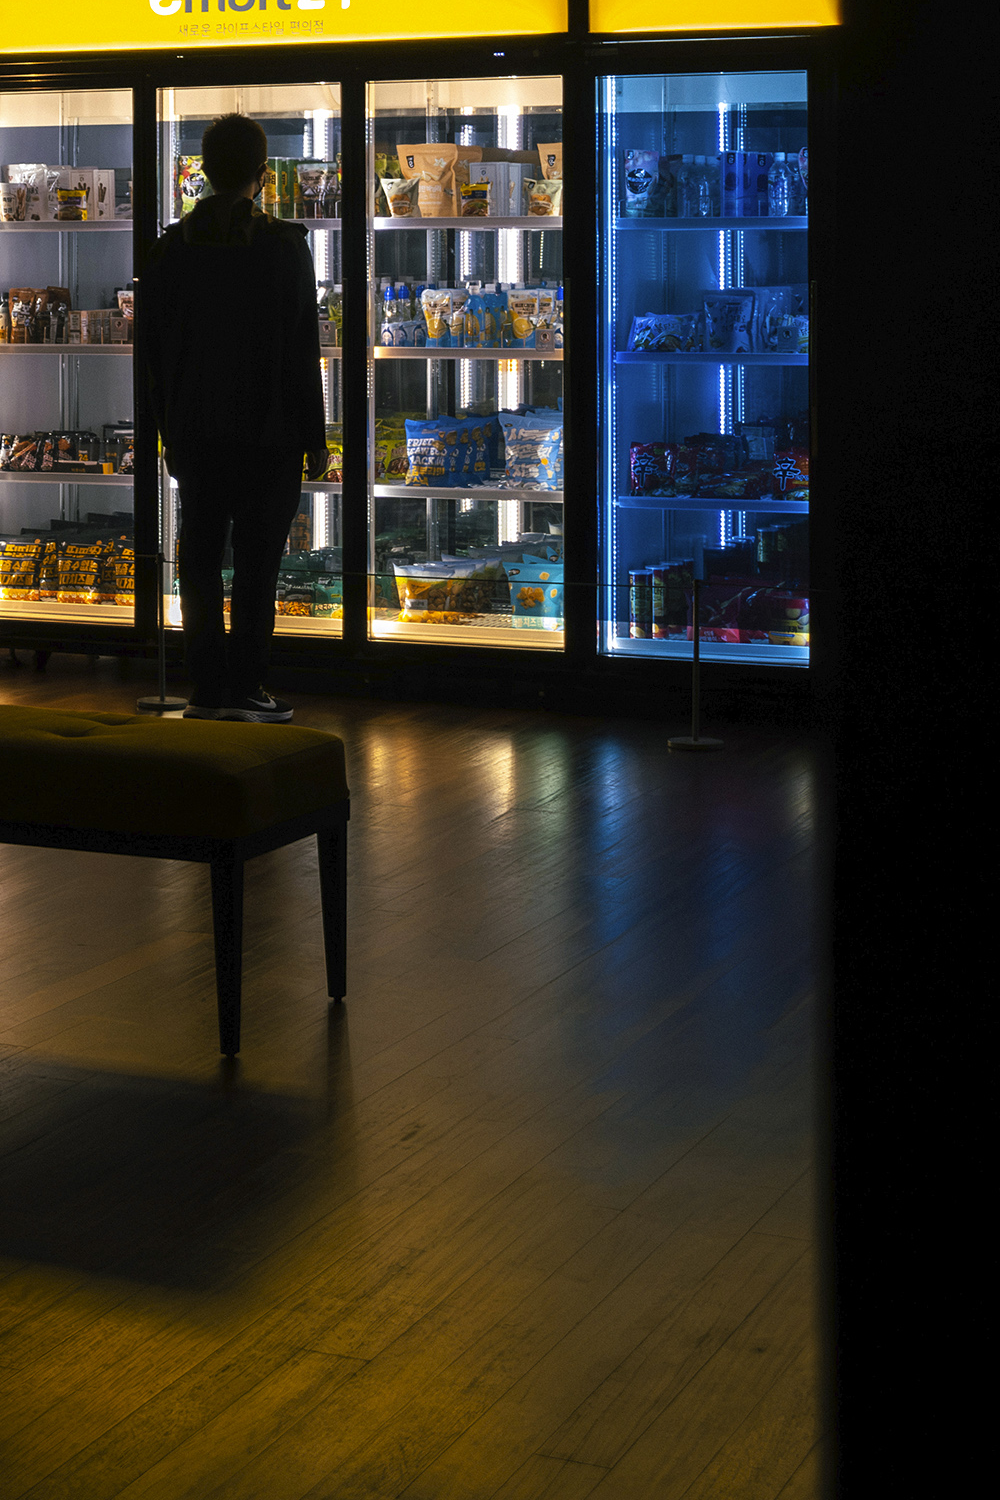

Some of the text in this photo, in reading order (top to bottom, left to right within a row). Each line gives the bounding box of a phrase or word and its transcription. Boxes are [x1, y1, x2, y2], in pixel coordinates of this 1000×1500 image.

[178, 19, 324, 37] 새로운 라이프스타일 편의점
[633, 452, 659, 489] 辛
[772, 456, 802, 491] 辛
